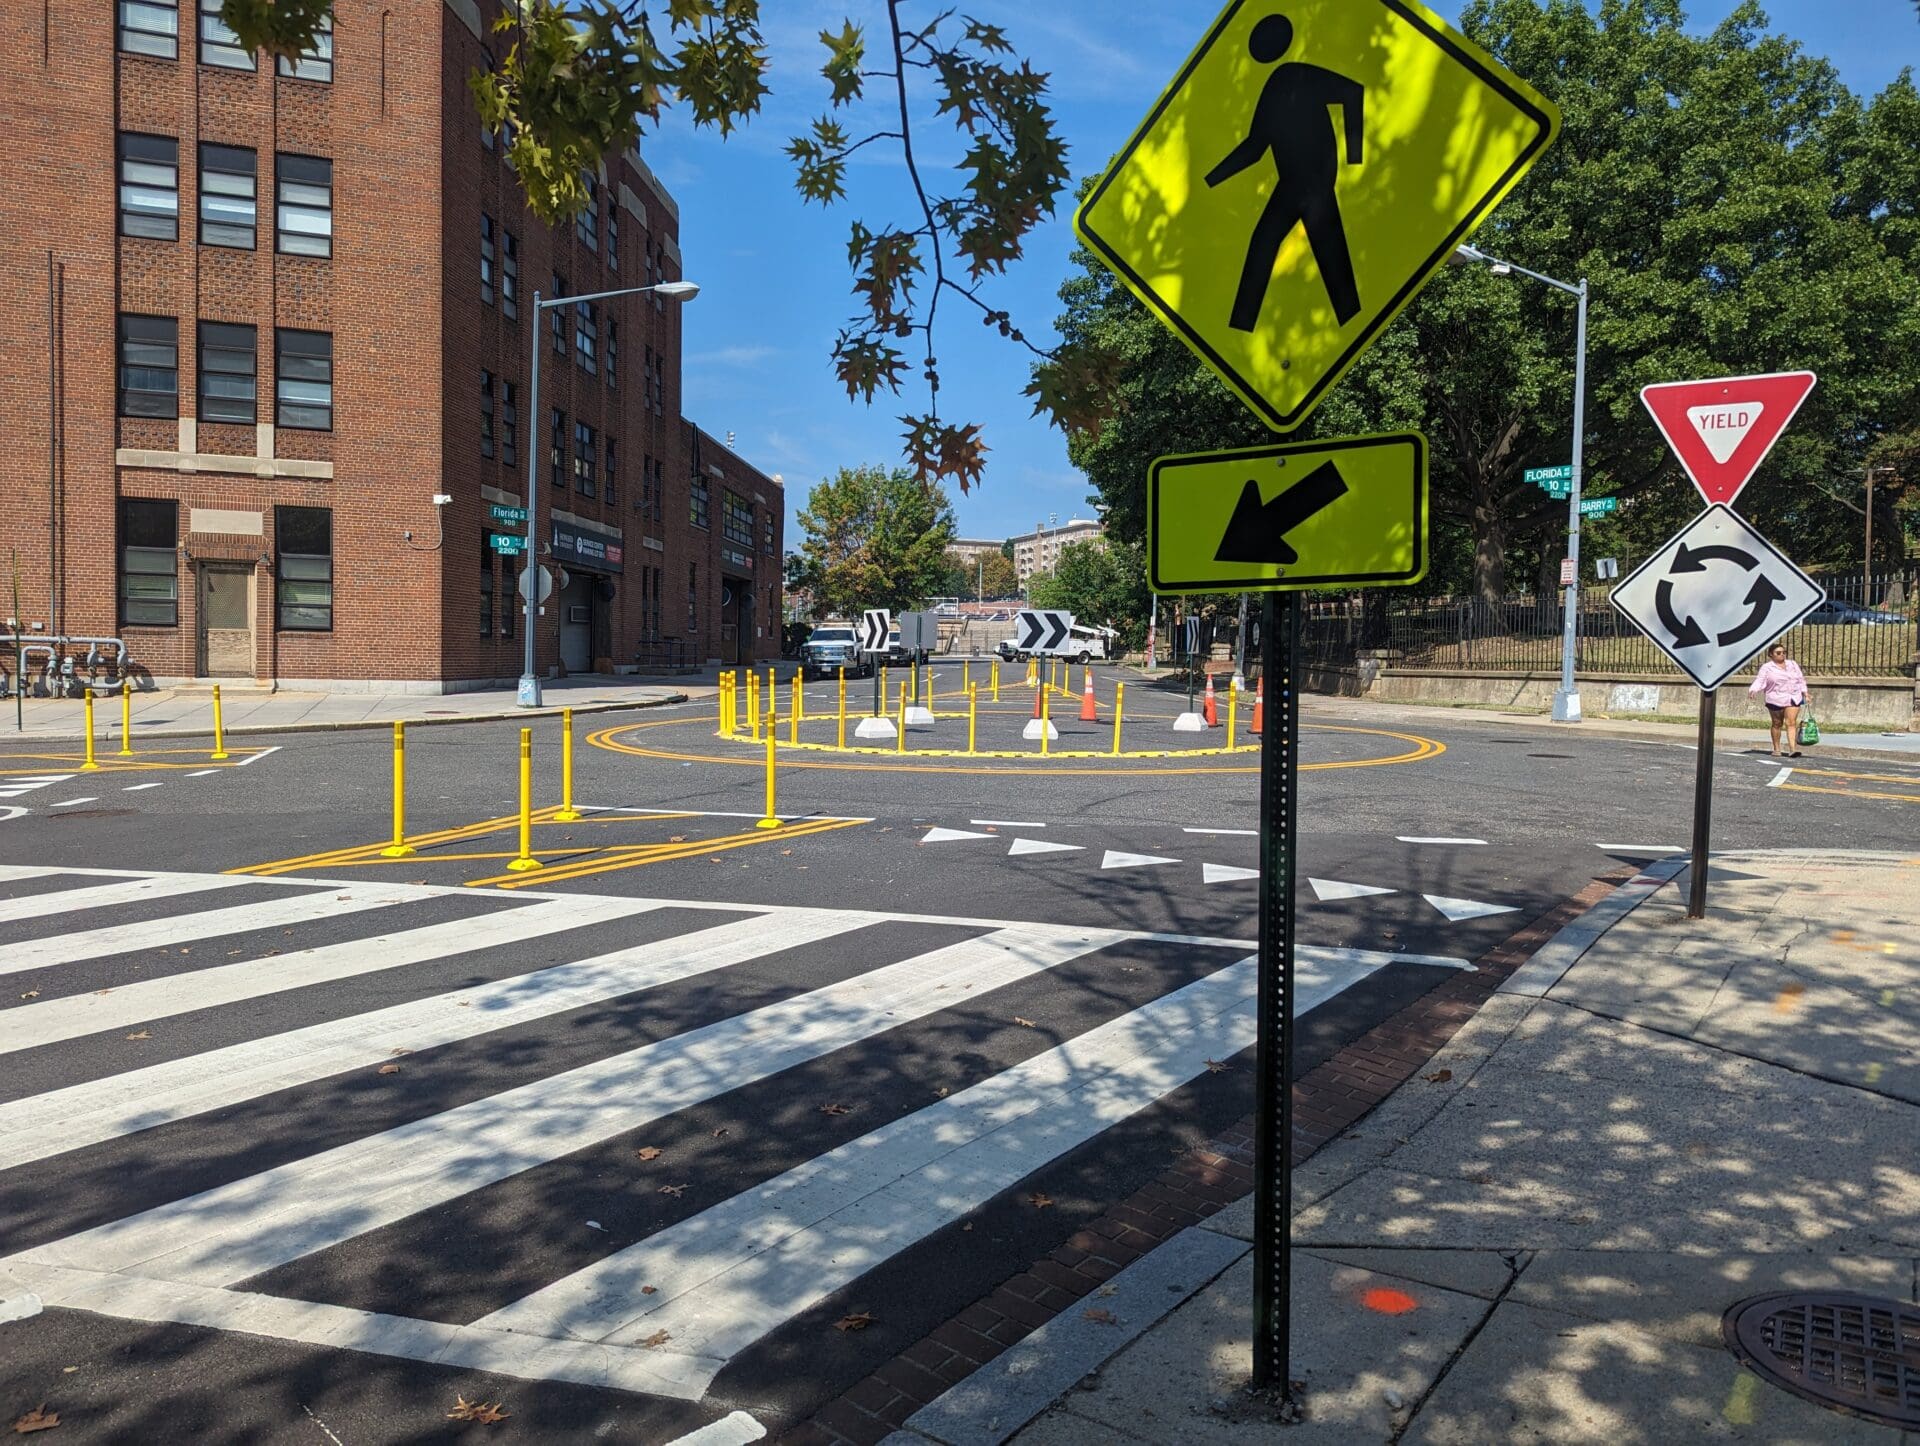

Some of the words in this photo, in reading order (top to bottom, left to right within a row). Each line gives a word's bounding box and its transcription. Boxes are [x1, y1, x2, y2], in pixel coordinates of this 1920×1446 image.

[1699, 411, 1749, 430] YIELD
[1526, 468, 1562, 481] FLORIDA
[1548, 480, 1559, 491] 10
[1550, 491, 1566, 499] 2200
[1580, 500, 1606, 513] BARRY
[493, 507, 519, 519] Florida
[503, 519, 516, 527] 900
[496, 536, 510, 547] 10
